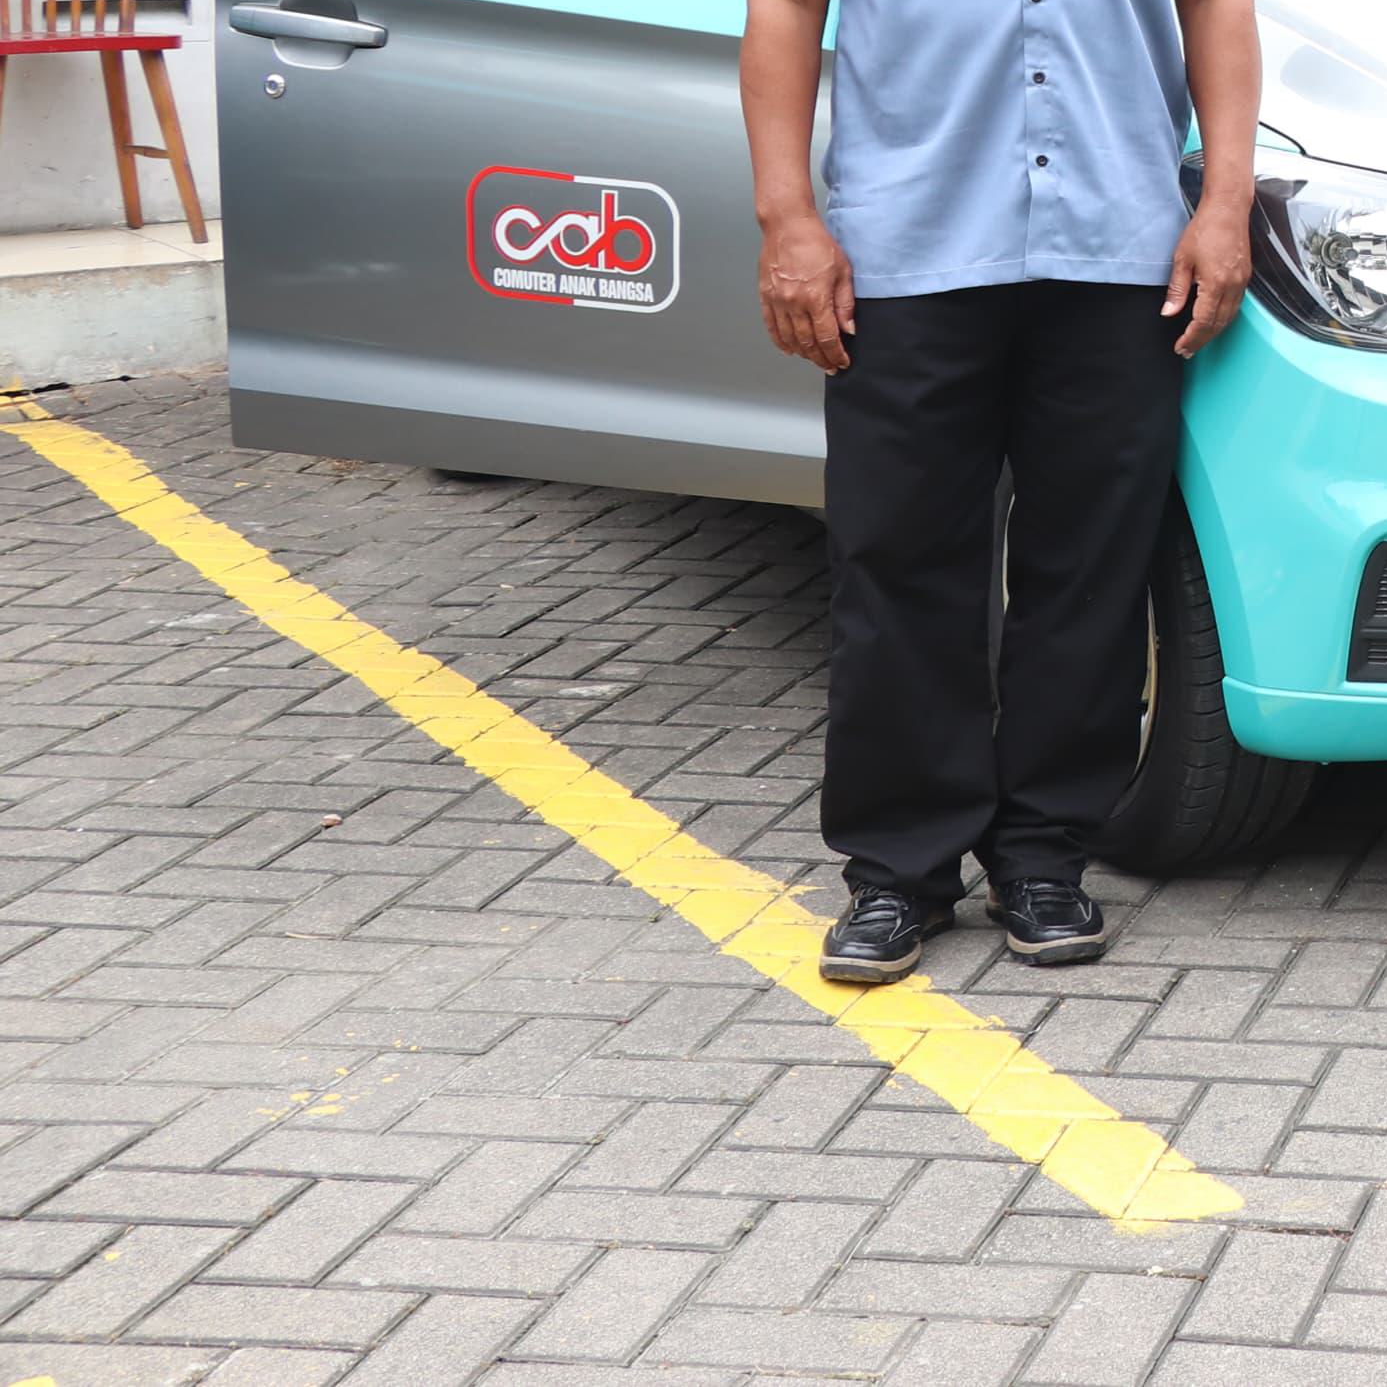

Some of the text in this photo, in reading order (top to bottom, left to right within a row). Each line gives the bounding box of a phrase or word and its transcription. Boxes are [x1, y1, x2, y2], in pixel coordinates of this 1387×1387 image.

[492, 189, 656, 275] cab
[493, 267, 654, 303] COMUTER ANAK BANGSA
